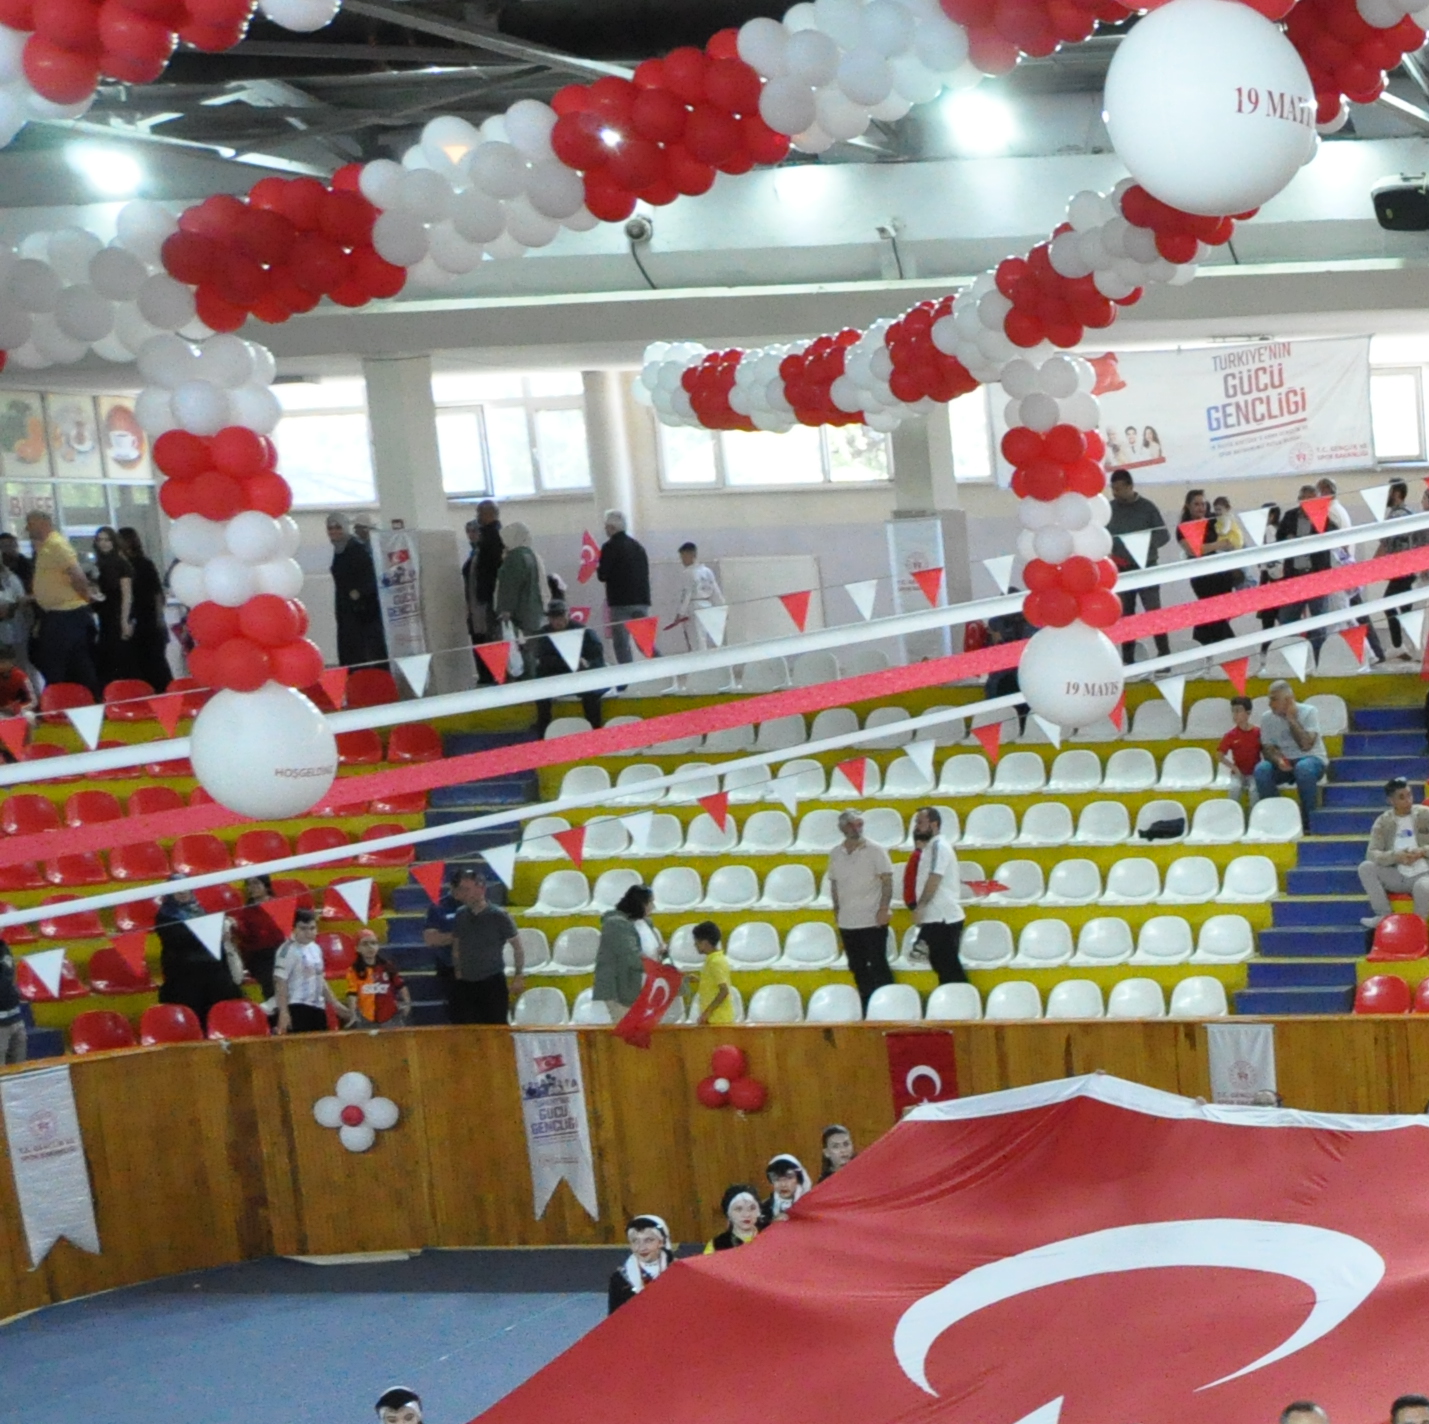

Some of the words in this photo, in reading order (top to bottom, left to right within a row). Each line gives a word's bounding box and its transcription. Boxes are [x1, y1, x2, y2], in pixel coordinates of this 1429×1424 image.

[1235, 87, 1260, 115] 19
[1223, 362, 1286, 399] GÜCÜ
[1206, 385, 1308, 432] GENÇLİĞİ
[1065, 681, 1080, 695] 19
